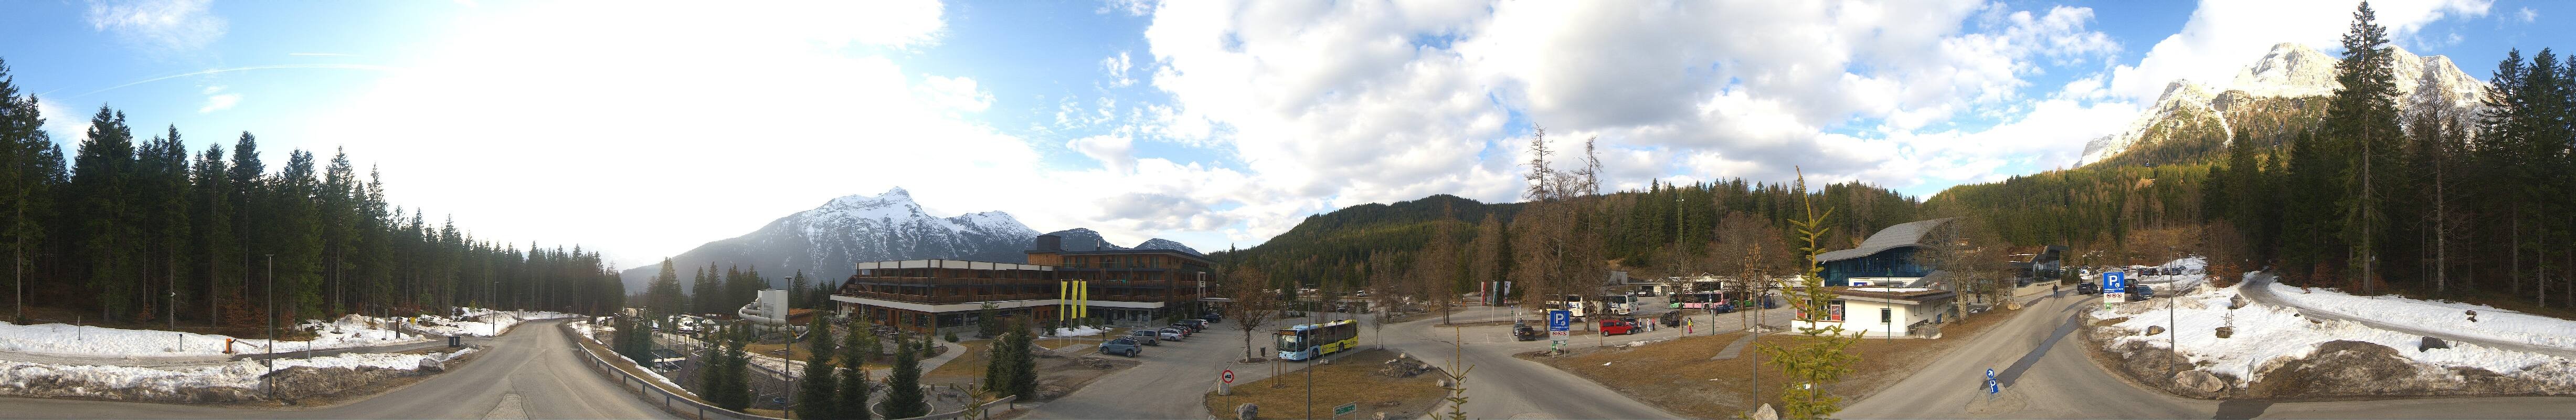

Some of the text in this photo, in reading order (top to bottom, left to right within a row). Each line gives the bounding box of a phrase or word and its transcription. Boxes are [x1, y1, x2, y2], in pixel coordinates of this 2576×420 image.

[2109, 275, 2118, 286] P
[1555, 313, 1564, 324] P
[1989, 380, 1996, 393] P
